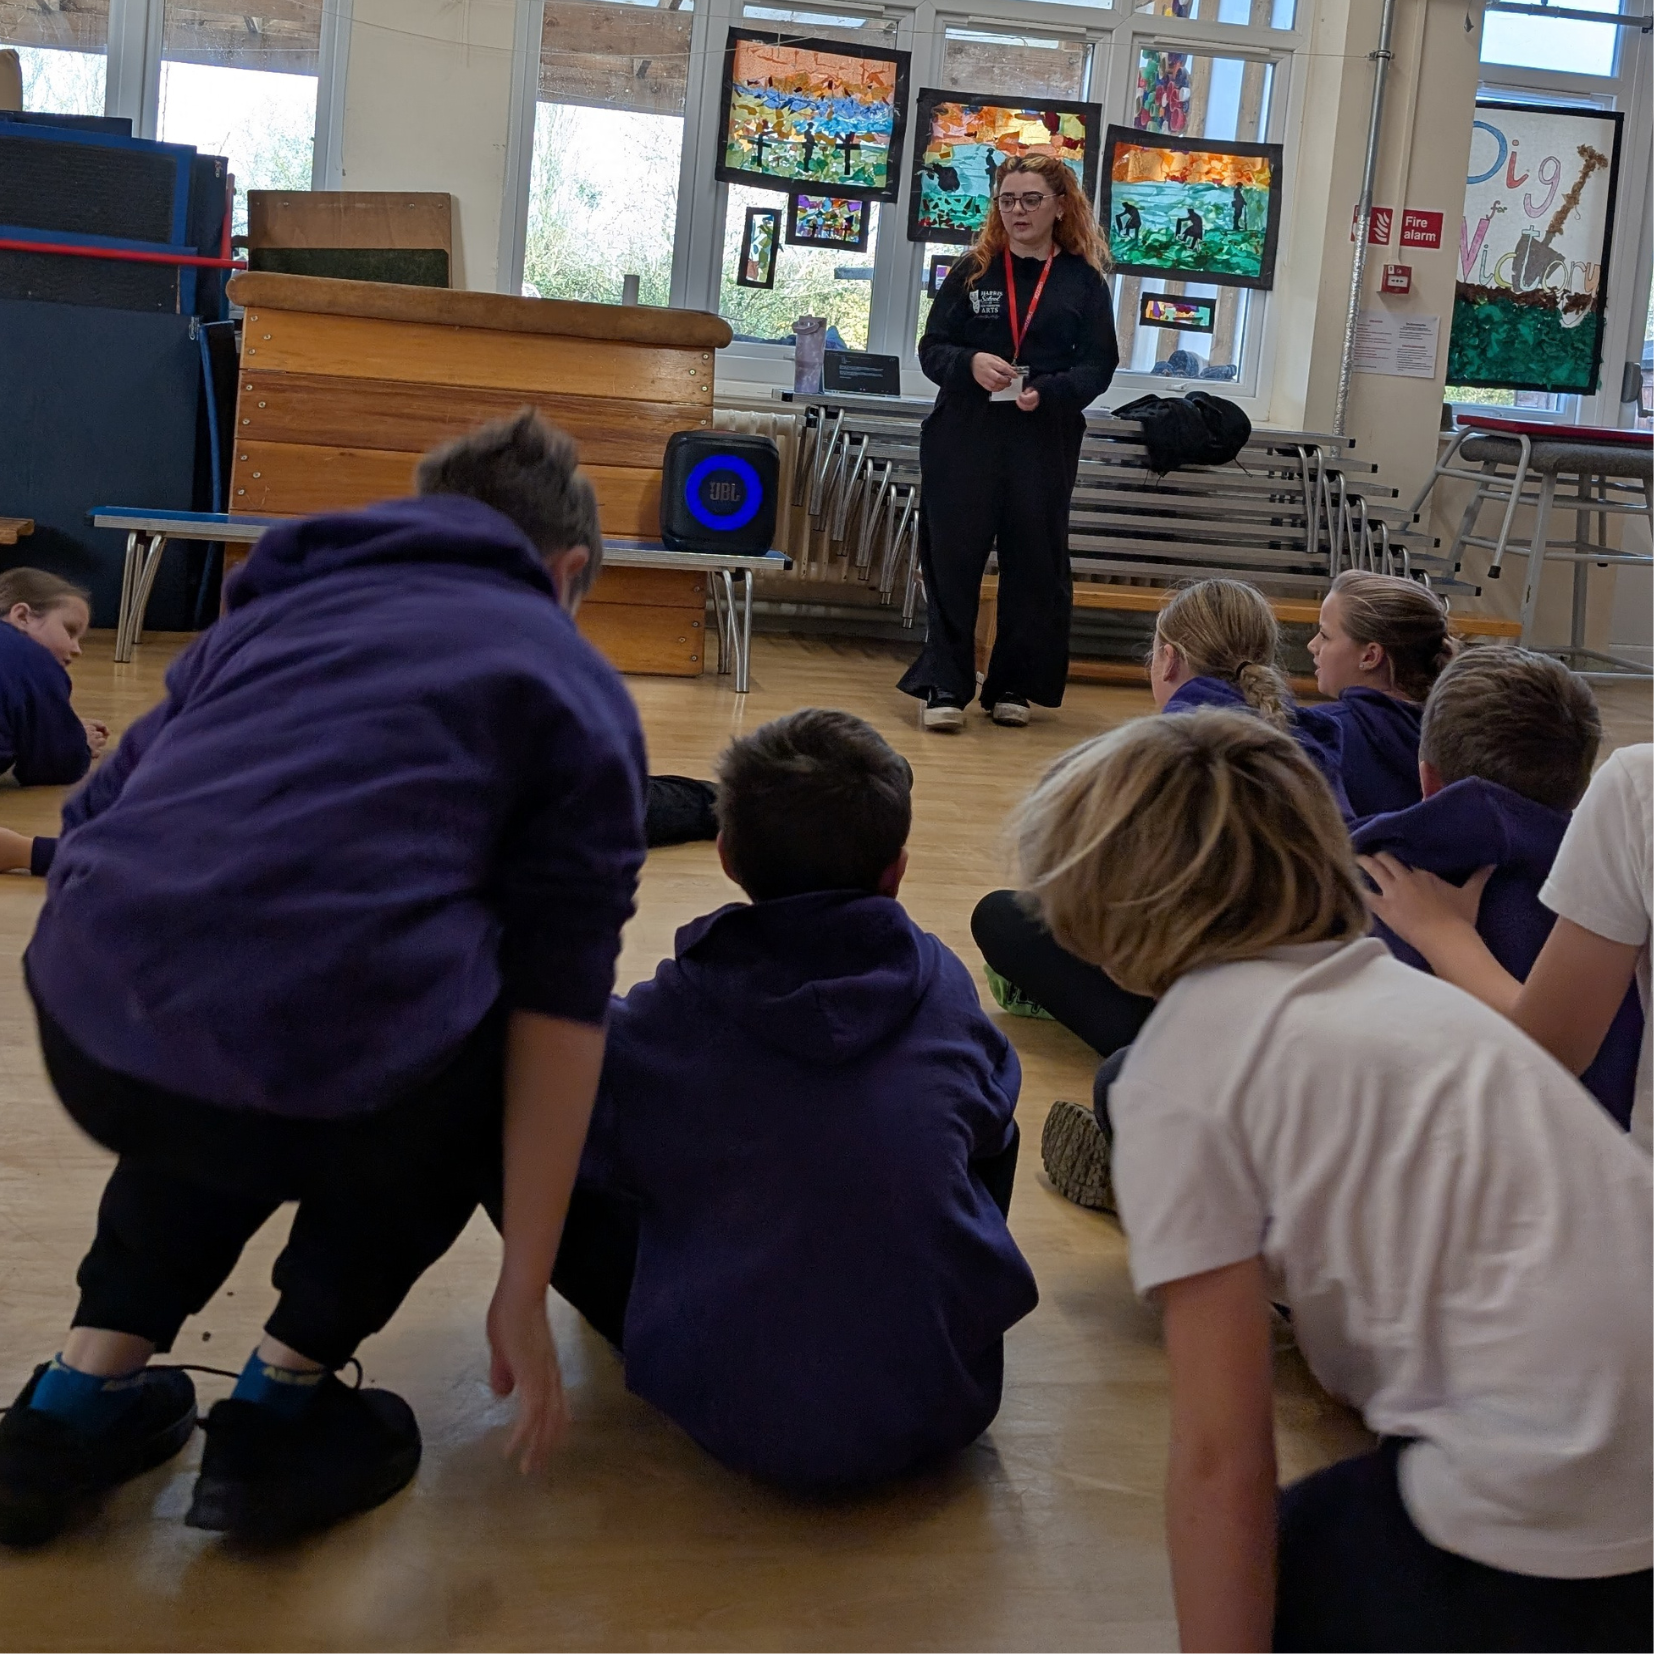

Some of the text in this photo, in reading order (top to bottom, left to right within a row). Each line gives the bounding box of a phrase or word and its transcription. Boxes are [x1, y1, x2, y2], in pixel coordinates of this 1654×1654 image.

[1466, 120, 1561, 218] Dig
[1405, 216, 1428, 228] Fire
[1403, 230, 1436, 242] alarm
[1459, 216, 1601, 326] Victory
[709, 482, 741, 501] JBL
